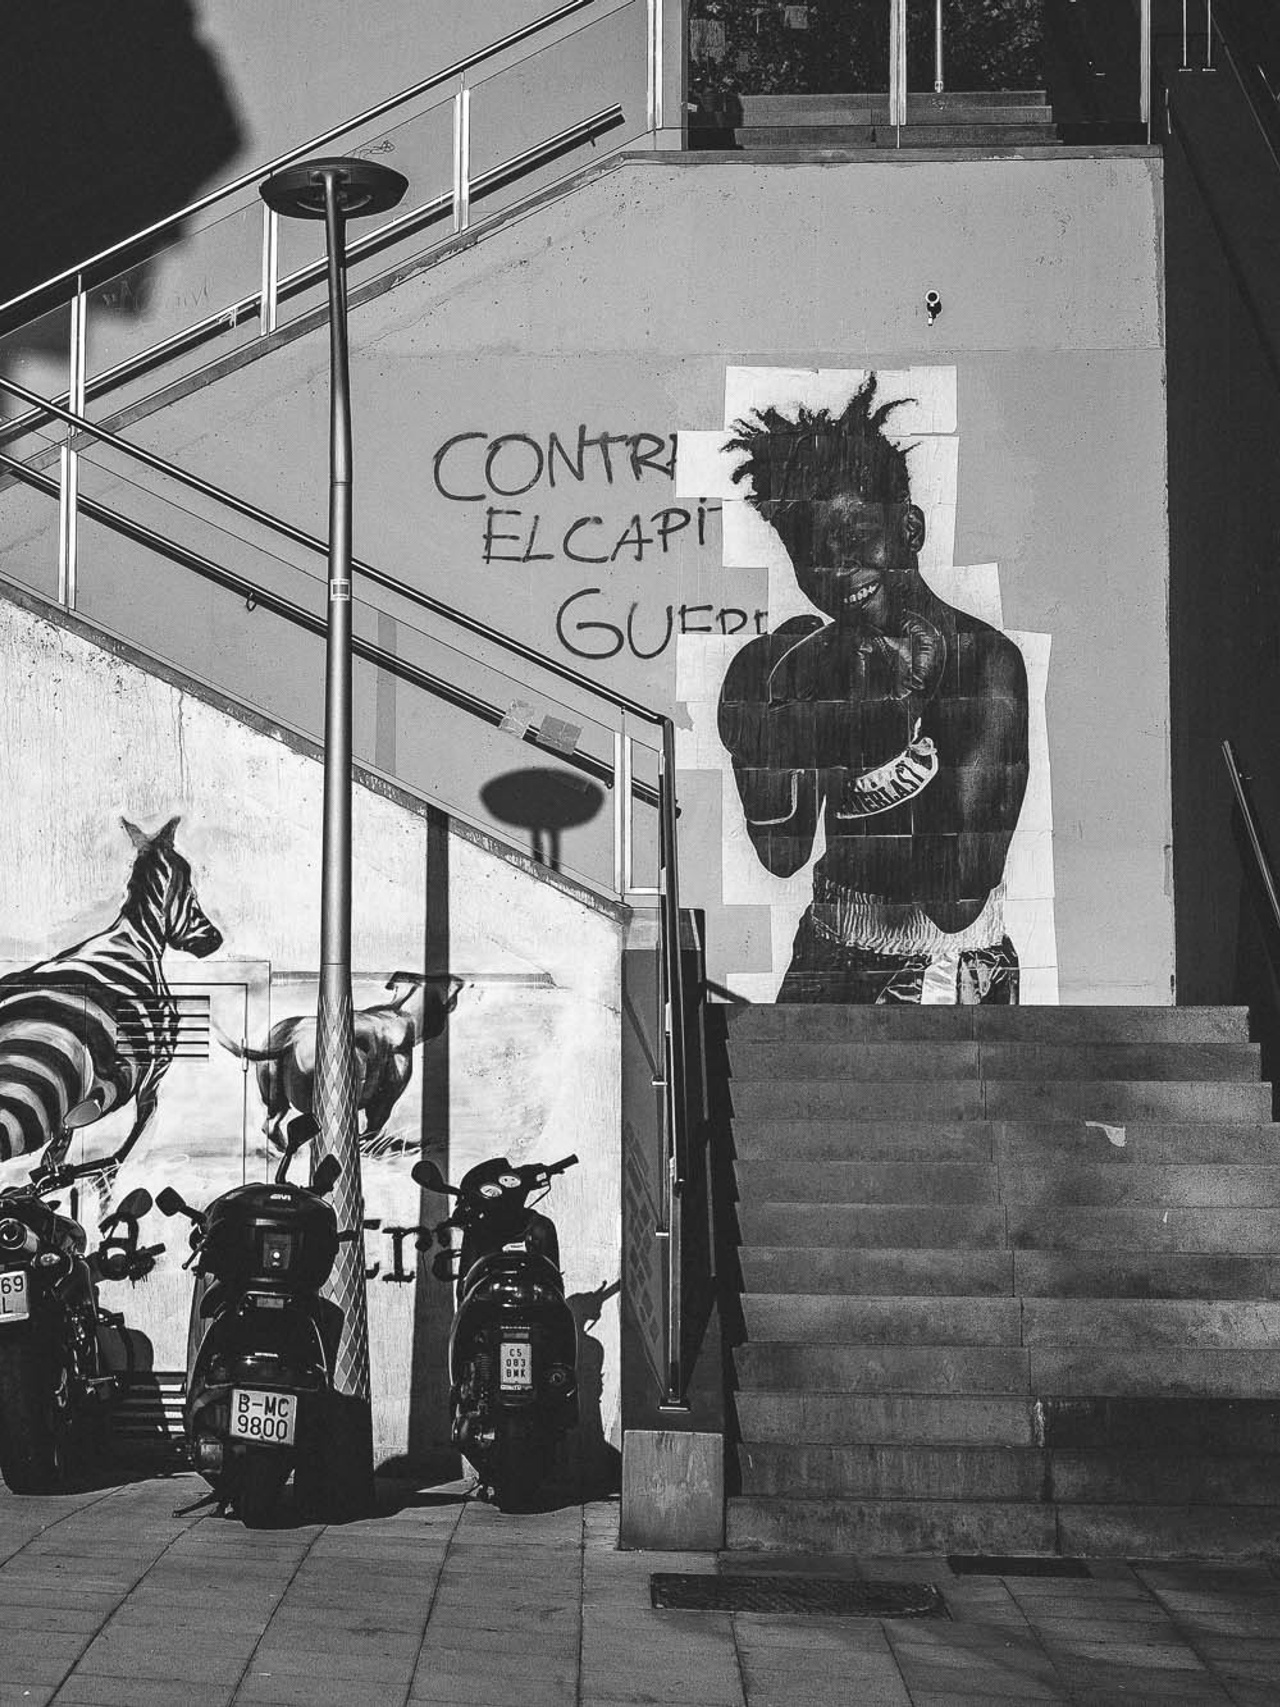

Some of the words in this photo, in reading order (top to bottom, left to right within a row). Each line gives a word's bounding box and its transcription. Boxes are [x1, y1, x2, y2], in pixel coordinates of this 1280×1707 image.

[482, 506, 554, 564] EL
[238, 1393, 290, 1418] B-MC
[237, 1414, 288, 1440] 9800
